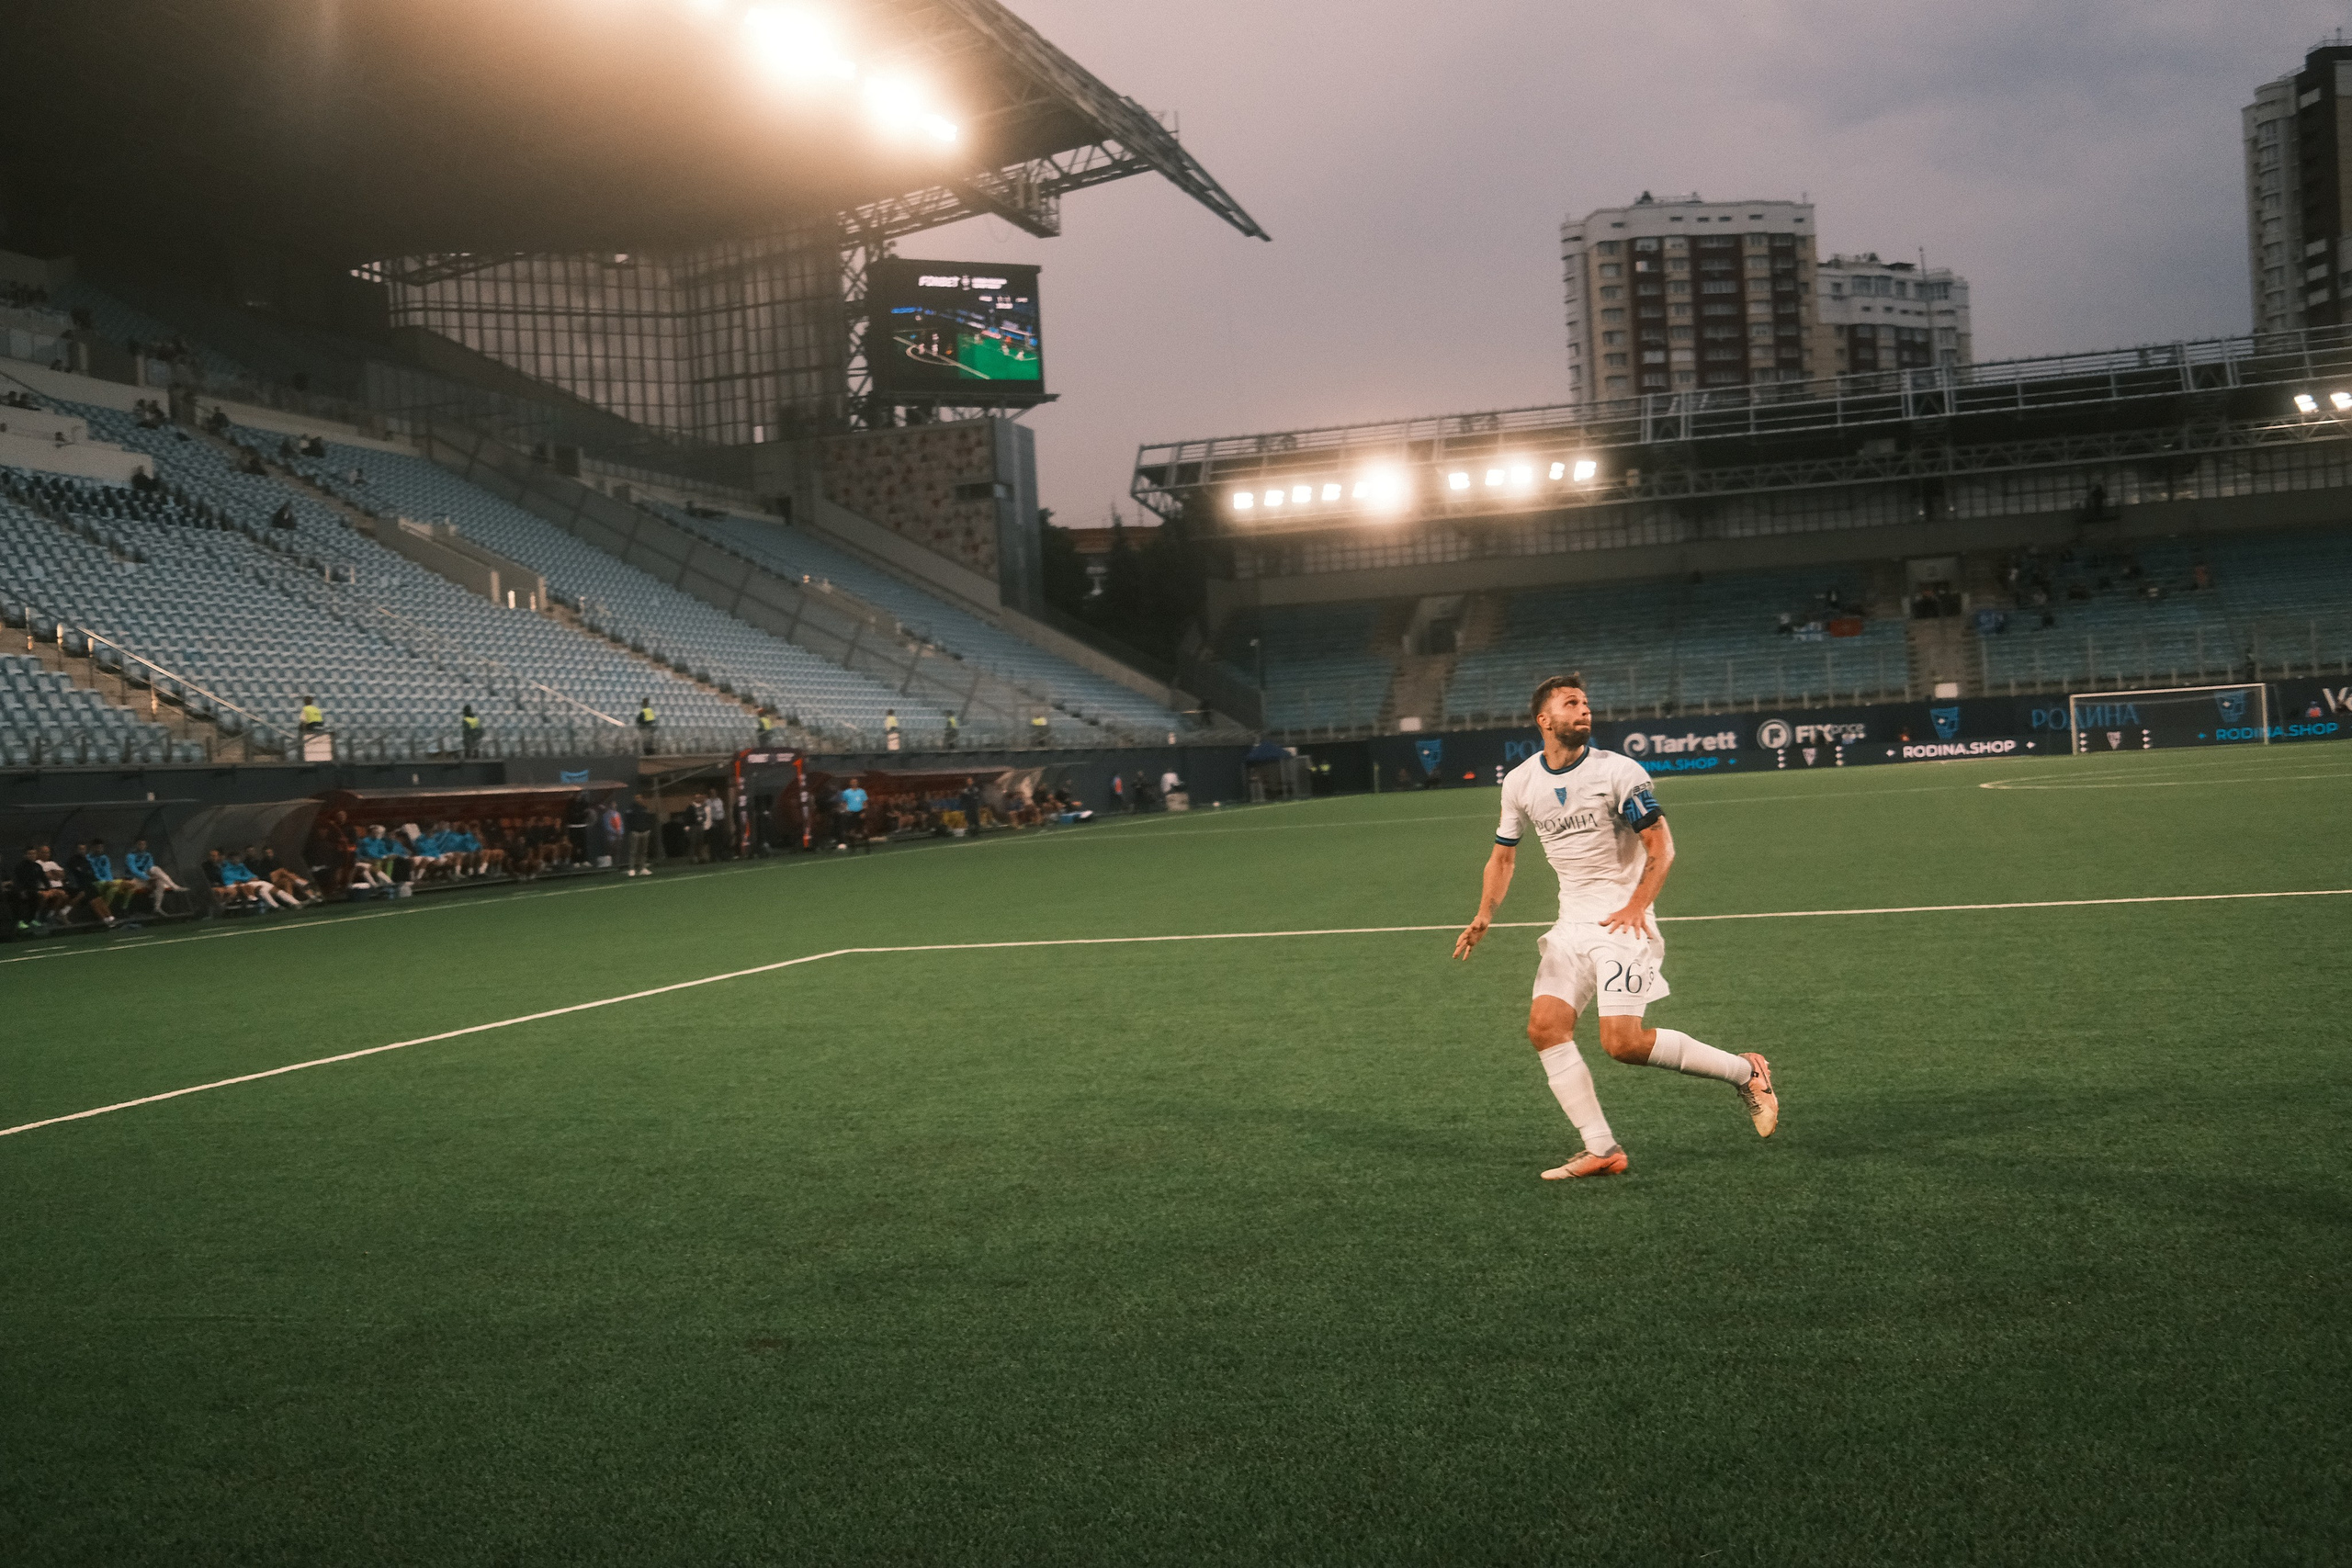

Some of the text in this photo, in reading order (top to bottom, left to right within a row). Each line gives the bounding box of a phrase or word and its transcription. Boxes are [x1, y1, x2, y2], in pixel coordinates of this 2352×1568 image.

[2216, 723, 2338, 740] RODINA.SHOP
[1650, 732, 1737, 753] Tarkett
[1903, 739, 2017, 759] RODINA.SHOP
[1638, 757, 1718, 772] INA.SHOP
[1604, 959, 1643, 994] 26
